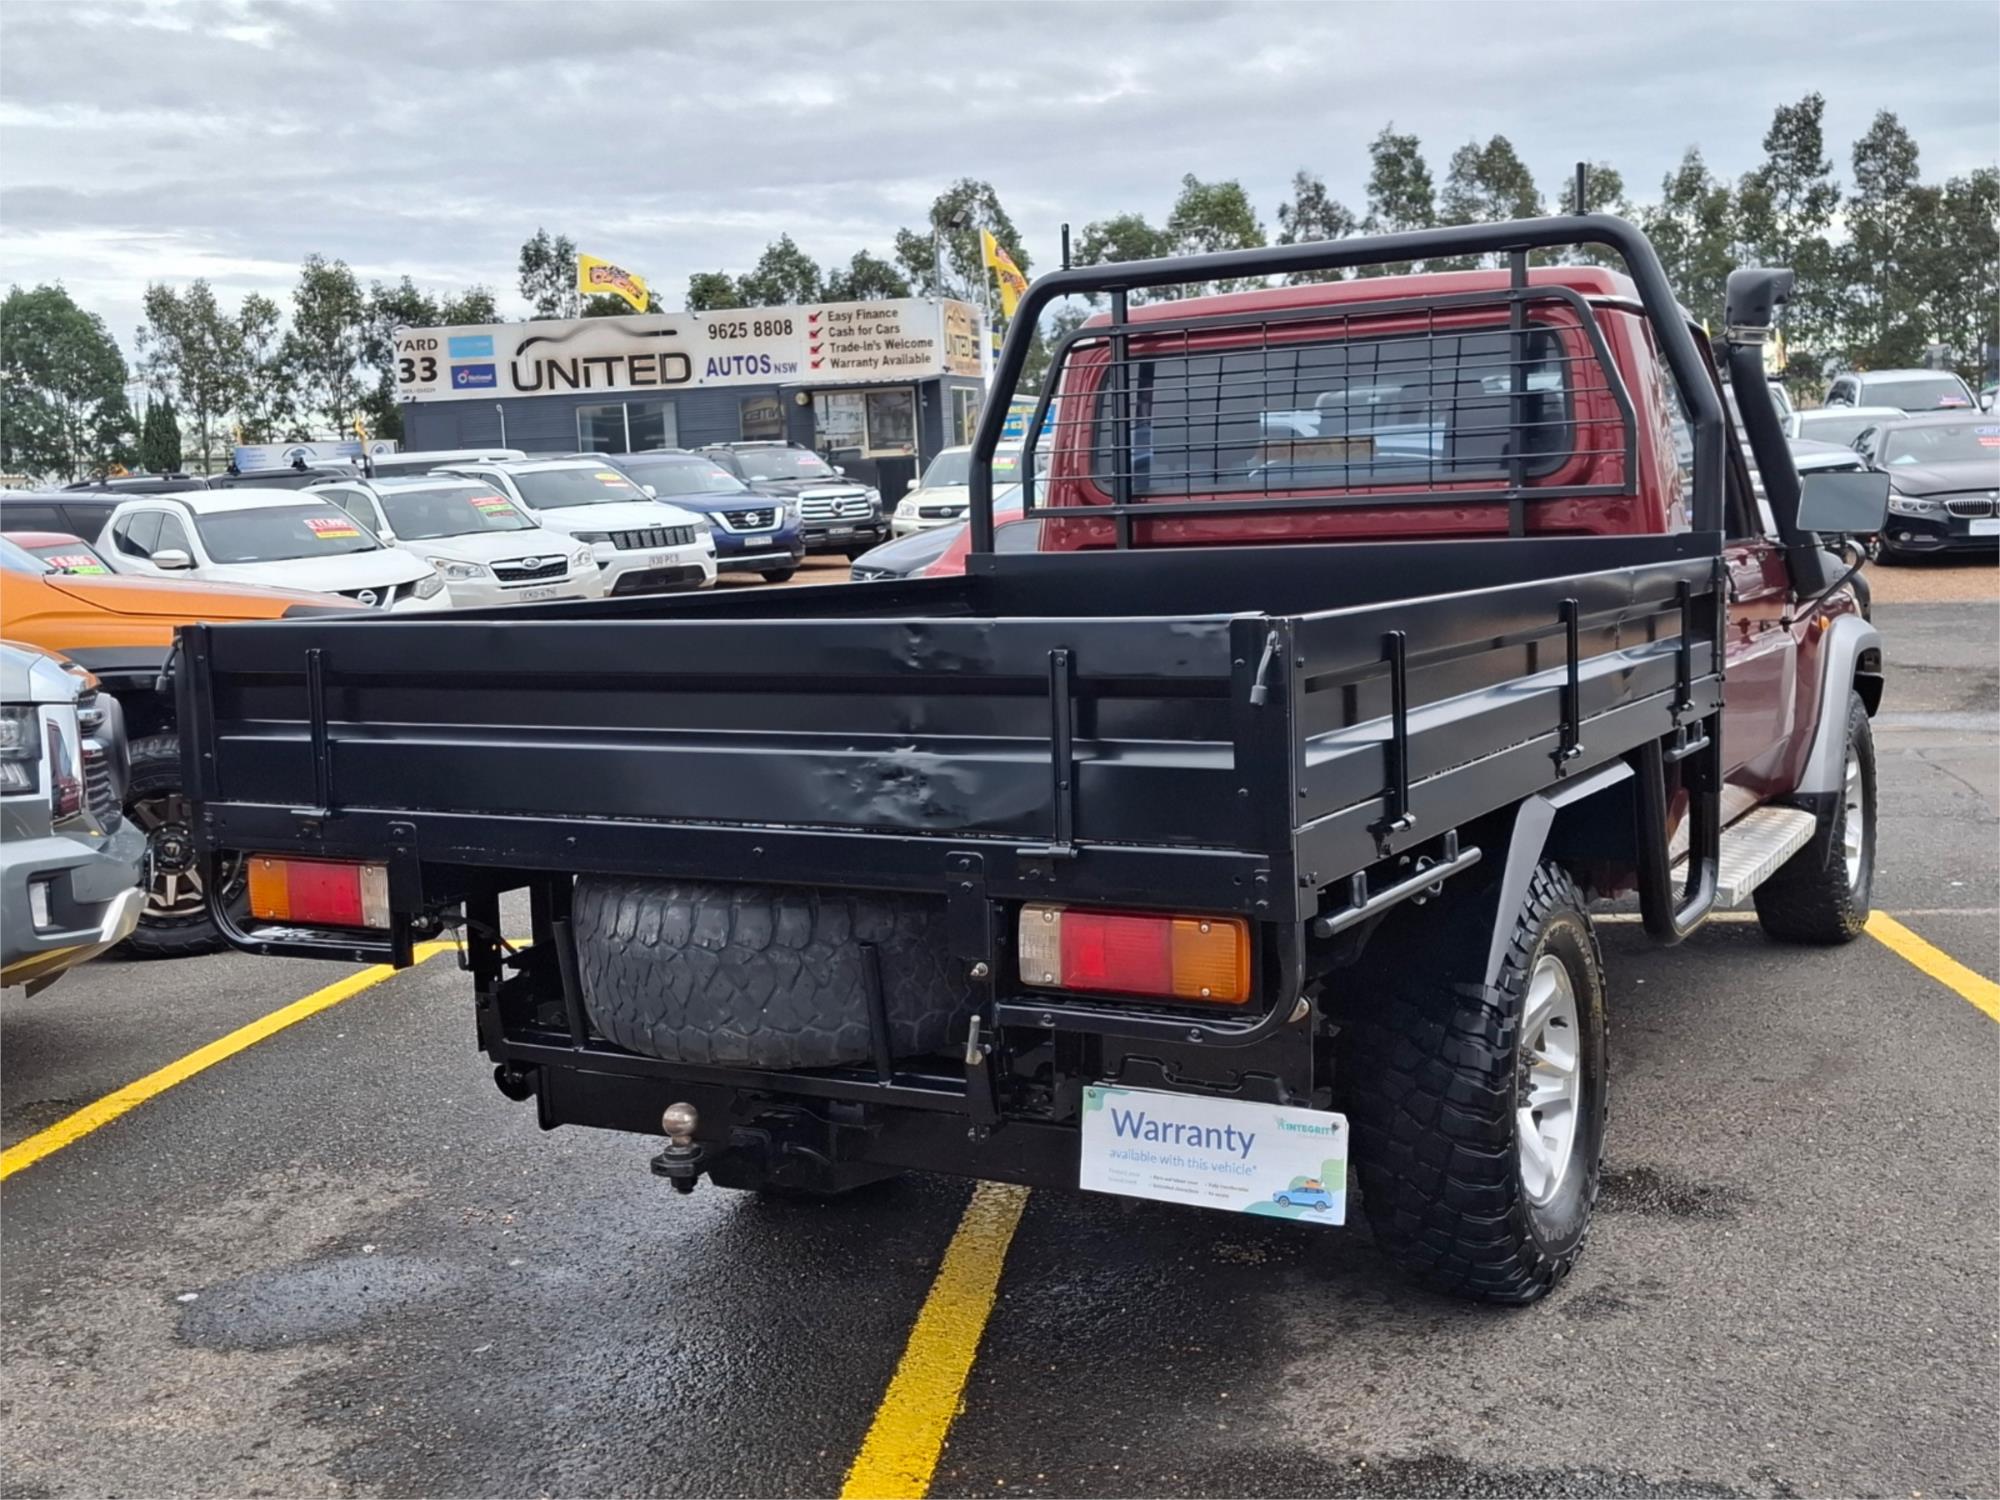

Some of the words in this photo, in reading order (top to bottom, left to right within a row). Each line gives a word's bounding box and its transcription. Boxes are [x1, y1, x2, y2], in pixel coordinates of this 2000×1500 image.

[828, 312, 853, 323] Easy
[856, 308, 899, 321] Finance
[708, 323, 748, 340] 9625
[753, 319, 793, 338] 8808
[828, 327, 855, 338] Cash
[858, 326, 873, 335] for
[876, 324, 900, 335] Cars
[395, 338, 438, 352] YARD
[829, 341, 882, 353] Trade-In's
[884, 337, 934, 350] Welcome
[399, 356, 438, 383] 33
[706, 354, 771, 377] AUTOS
[774, 362, 798, 375] NSW
[830, 357, 879, 370] Warranty
[881, 353, 931, 365] Available
[1111, 1108, 1255, 1158] Warranty
[1109, 1149, 1157, 1164] available
[1160, 1153, 1185, 1168] with
[1187, 1158, 1208, 1171] this
